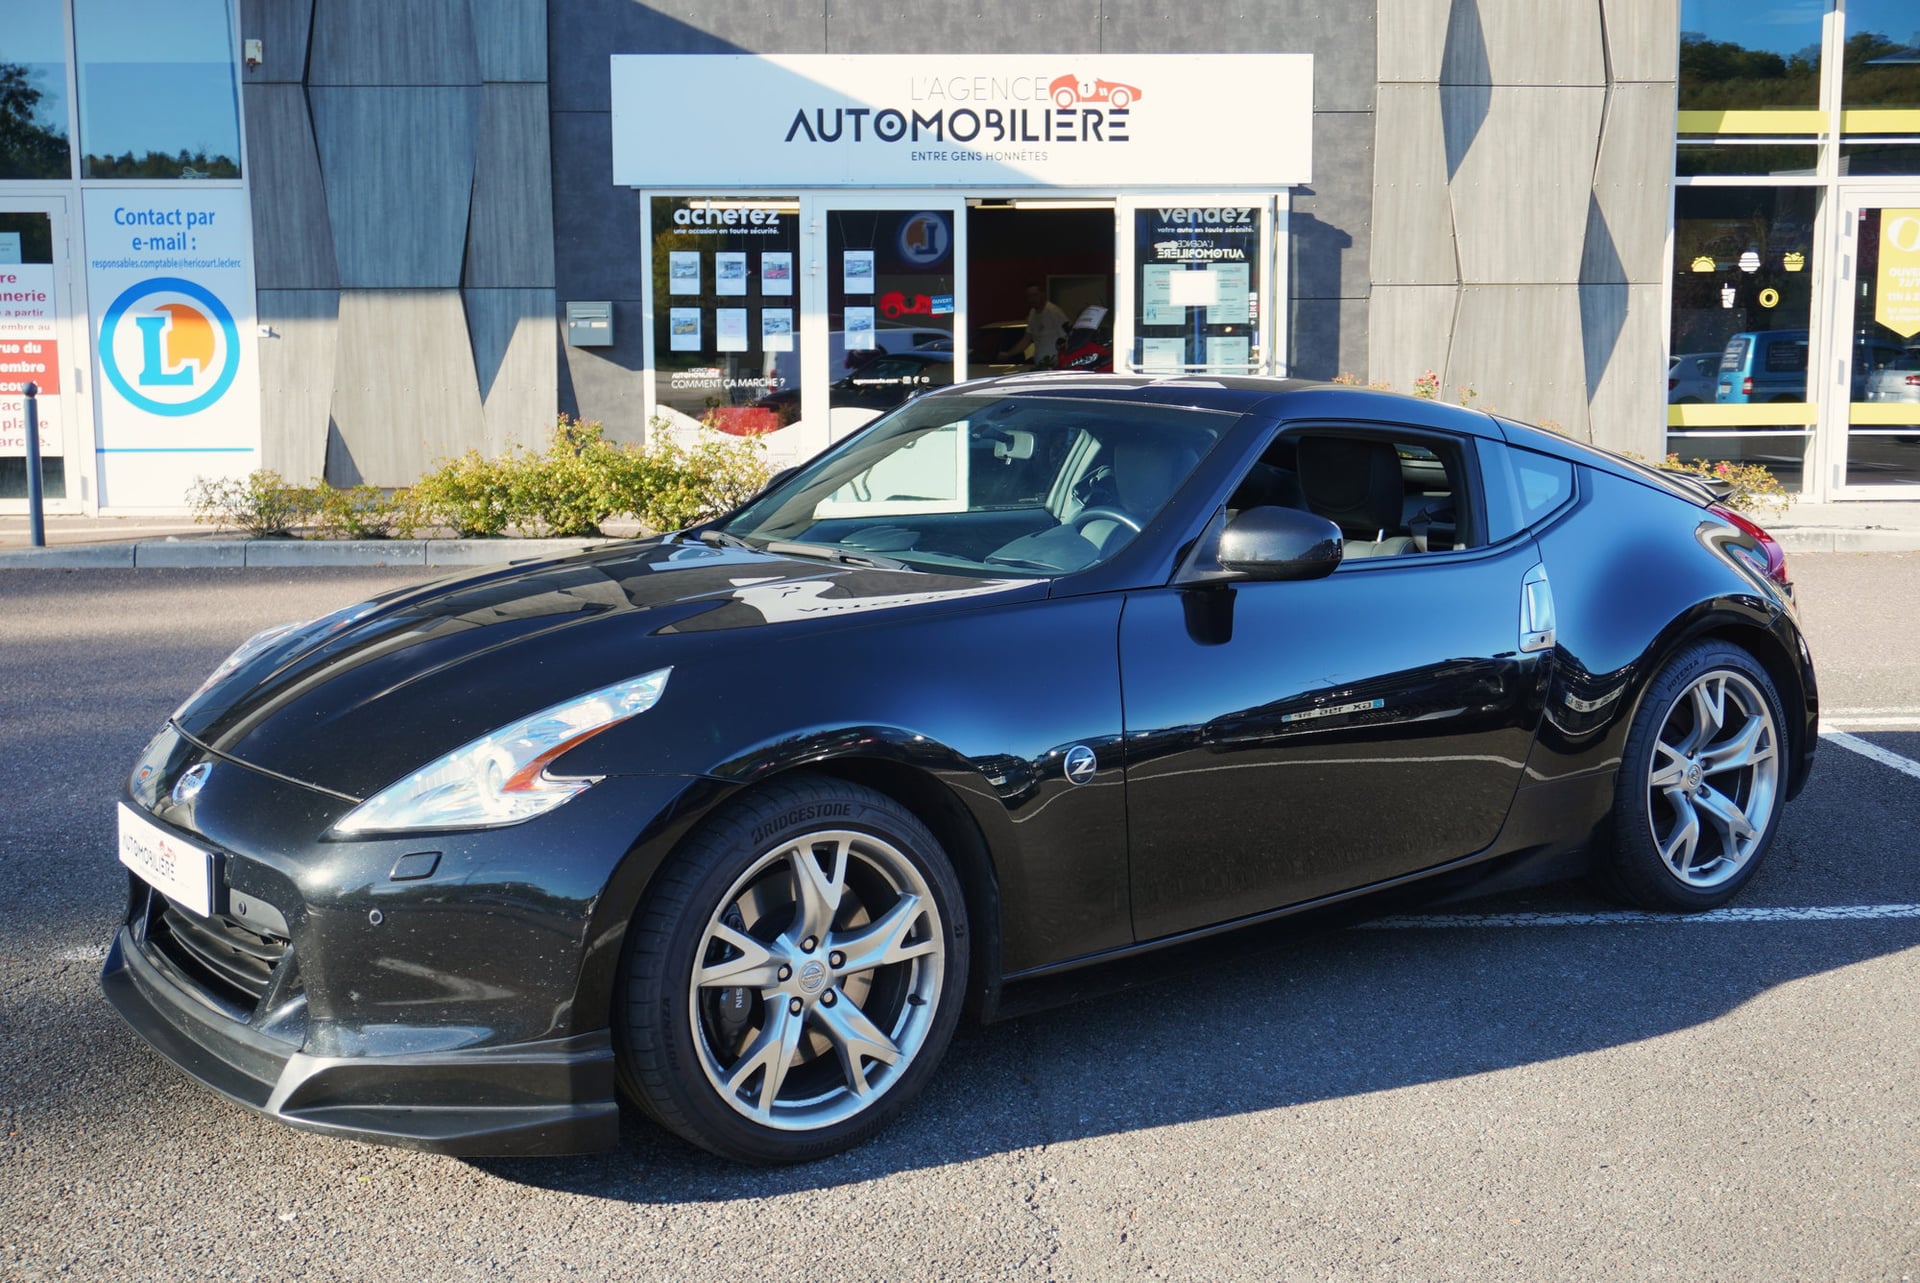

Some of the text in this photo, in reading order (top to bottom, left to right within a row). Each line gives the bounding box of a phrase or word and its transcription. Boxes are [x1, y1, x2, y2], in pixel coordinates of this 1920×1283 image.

[911, 76, 1049, 101] L'AGENCE
[784, 108, 1130, 142] AUTOMOBILIERE
[911, 149, 1049, 161] ENTRE GENS HONNÊTES
[114, 207, 216, 230] Contact par
[673, 199, 780, 225] achetez
[1157, 207, 1252, 223] vendez
[688, 227, 718, 235] occasion
[730, 227, 749, 235] toute
[132, 232, 187, 251] e-mail
[15, 308, 44, 318] partir
[23, 341, 42, 354] du
[671, 380, 721, 389] COMMENT
[723, 379, 737, 390] ÇA
[738, 378, 778, 388] MARCHE
[1071, 757, 1095, 776] Z
[750, 803, 851, 845] BRIDGESTONE
